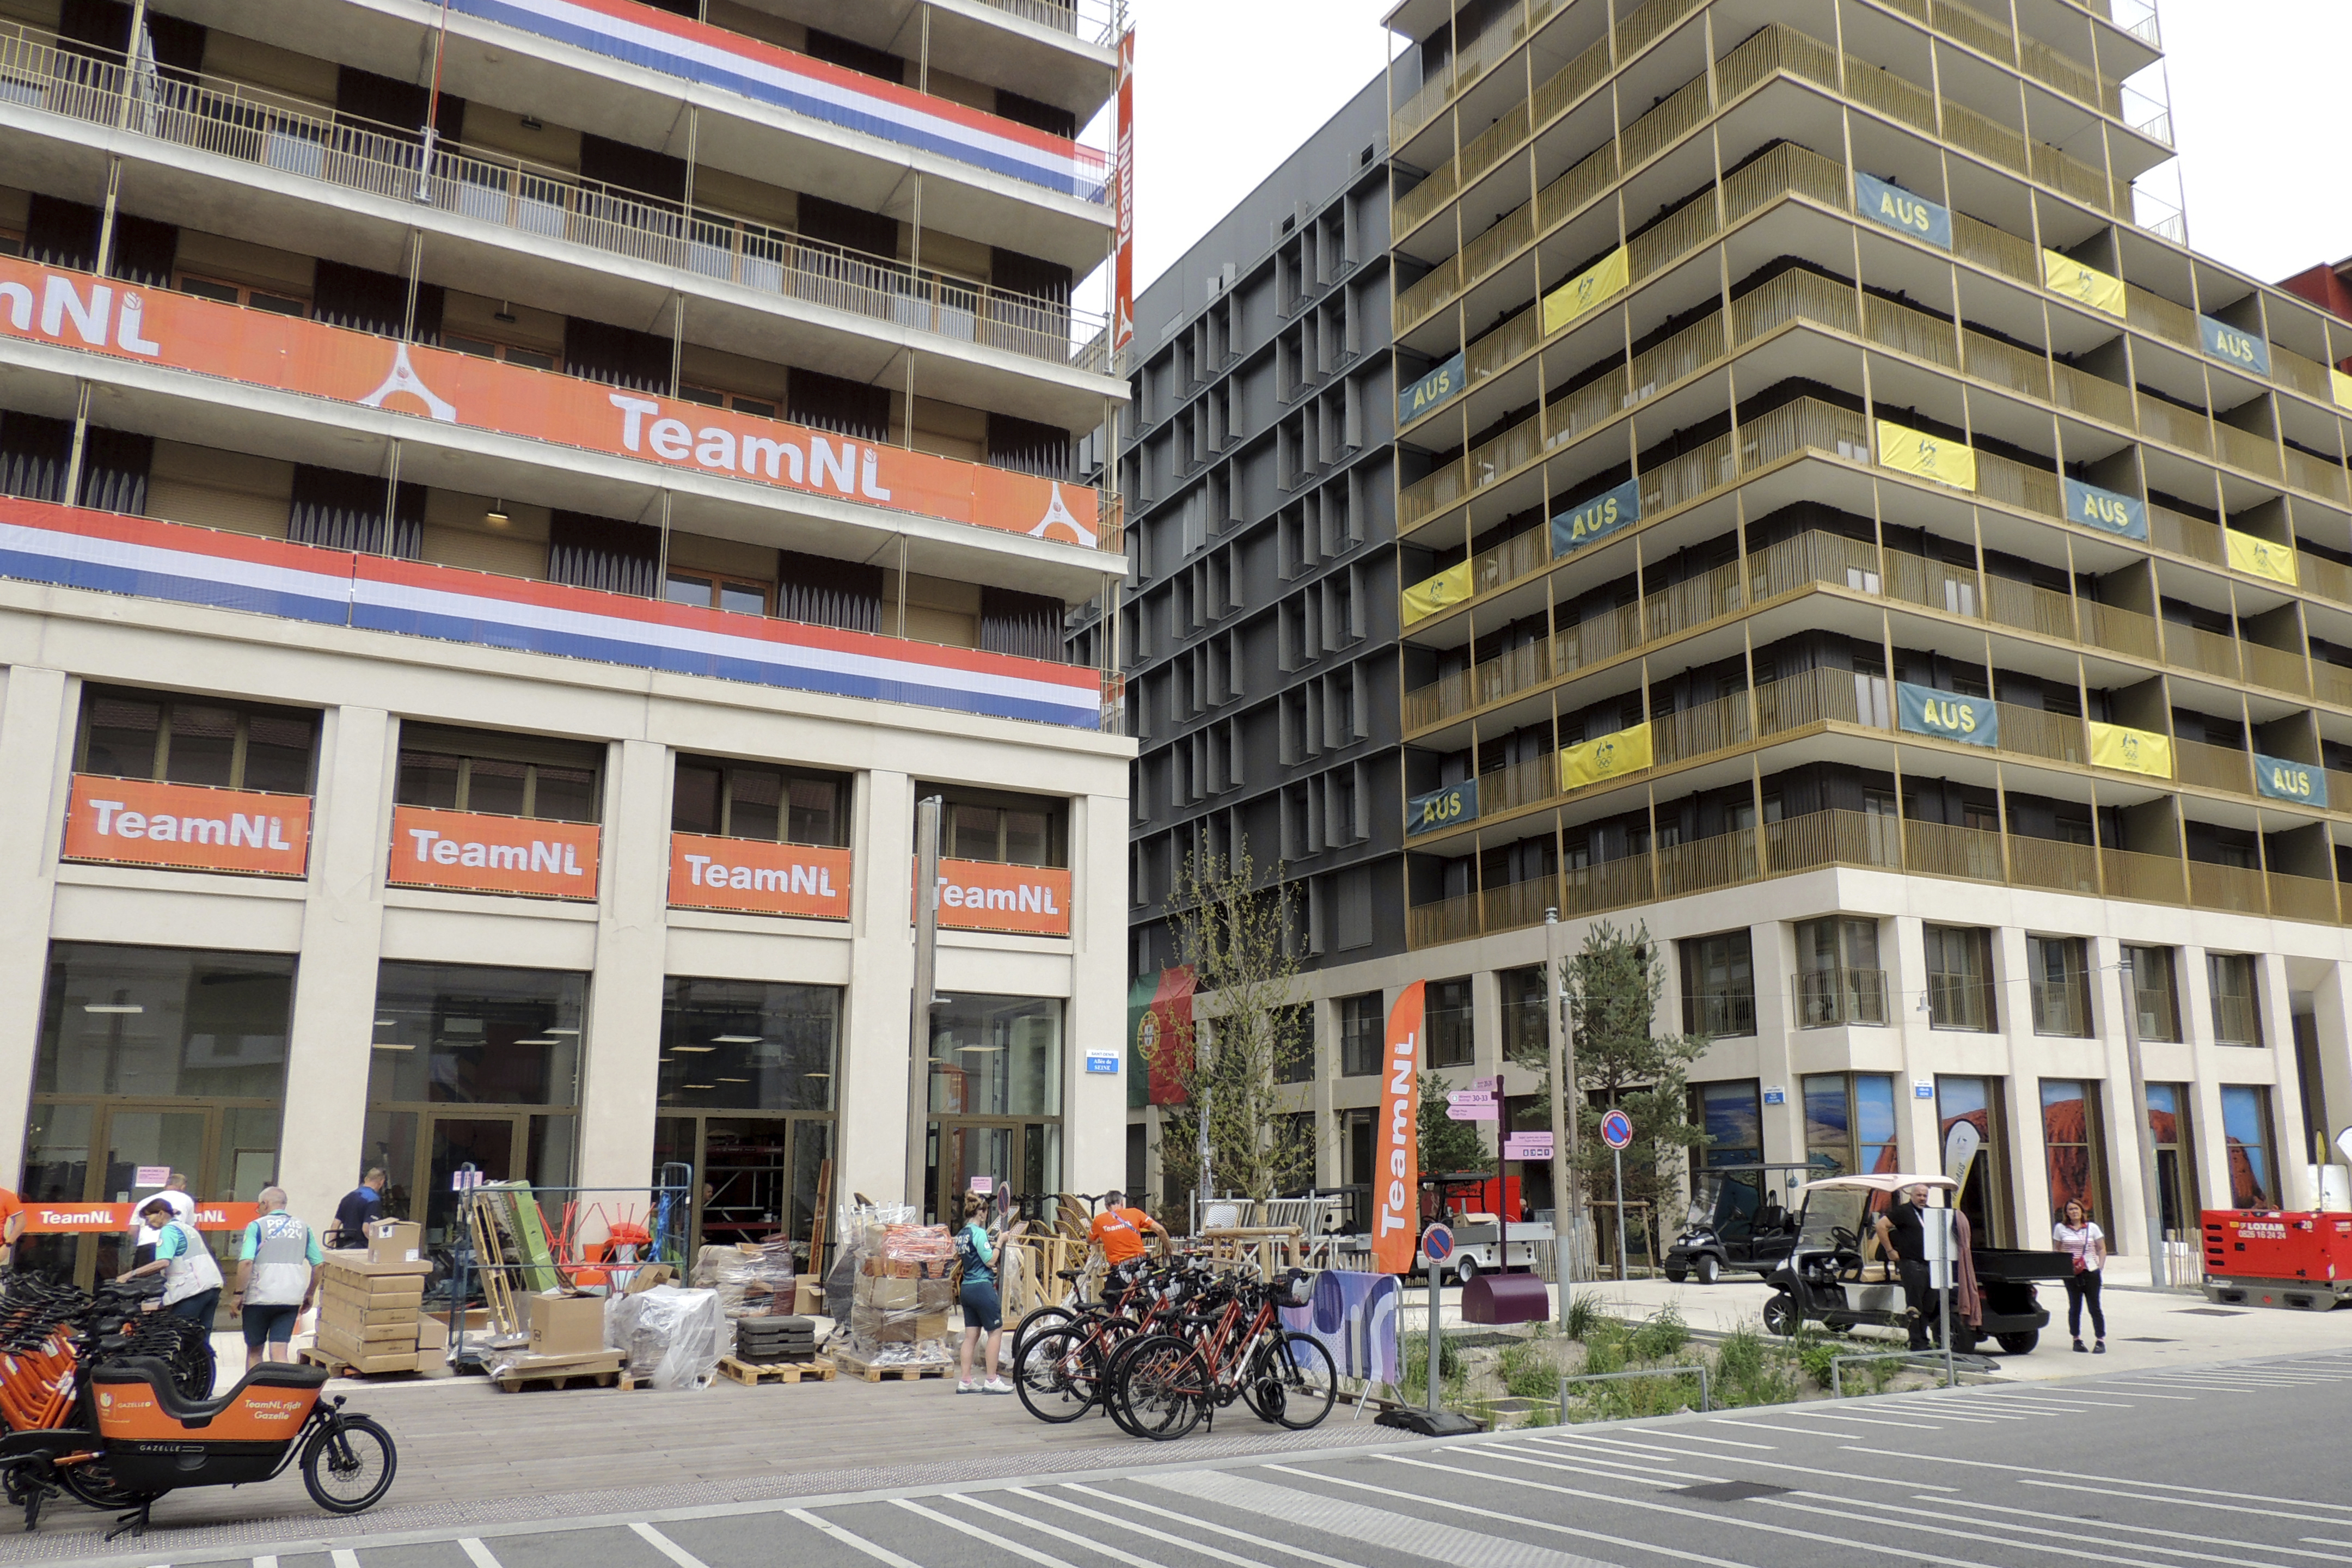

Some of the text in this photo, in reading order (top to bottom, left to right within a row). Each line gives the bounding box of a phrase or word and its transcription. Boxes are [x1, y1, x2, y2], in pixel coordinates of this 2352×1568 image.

[1117, 121, 1131, 255] TeamNL
[1880, 191, 1928, 231] AUS
[2216, 329, 2253, 362] AUS
[1413, 370, 1450, 409] AUS
[609, 393, 891, 501] TeamNL
[1571, 498, 1618, 540] AUS
[2084, 493, 2128, 526] AUS
[1924, 699, 1976, 733] AUS
[2273, 767, 2310, 796] AUS
[89, 799, 290, 850] TeamNL
[1423, 792, 1461, 823] AUS
[409, 828, 583, 875] TeamNL
[684, 854, 836, 897] TeamNL
[1381, 1032, 1414, 1238] TeamNL
[40, 1211, 113, 1224] TeamNL
[2247, 1220, 2312, 1231] LOXAM 20
[245, 1399, 302, 1411] TeamNL rijdt
[254, 1411, 289, 1420] Gazelle
